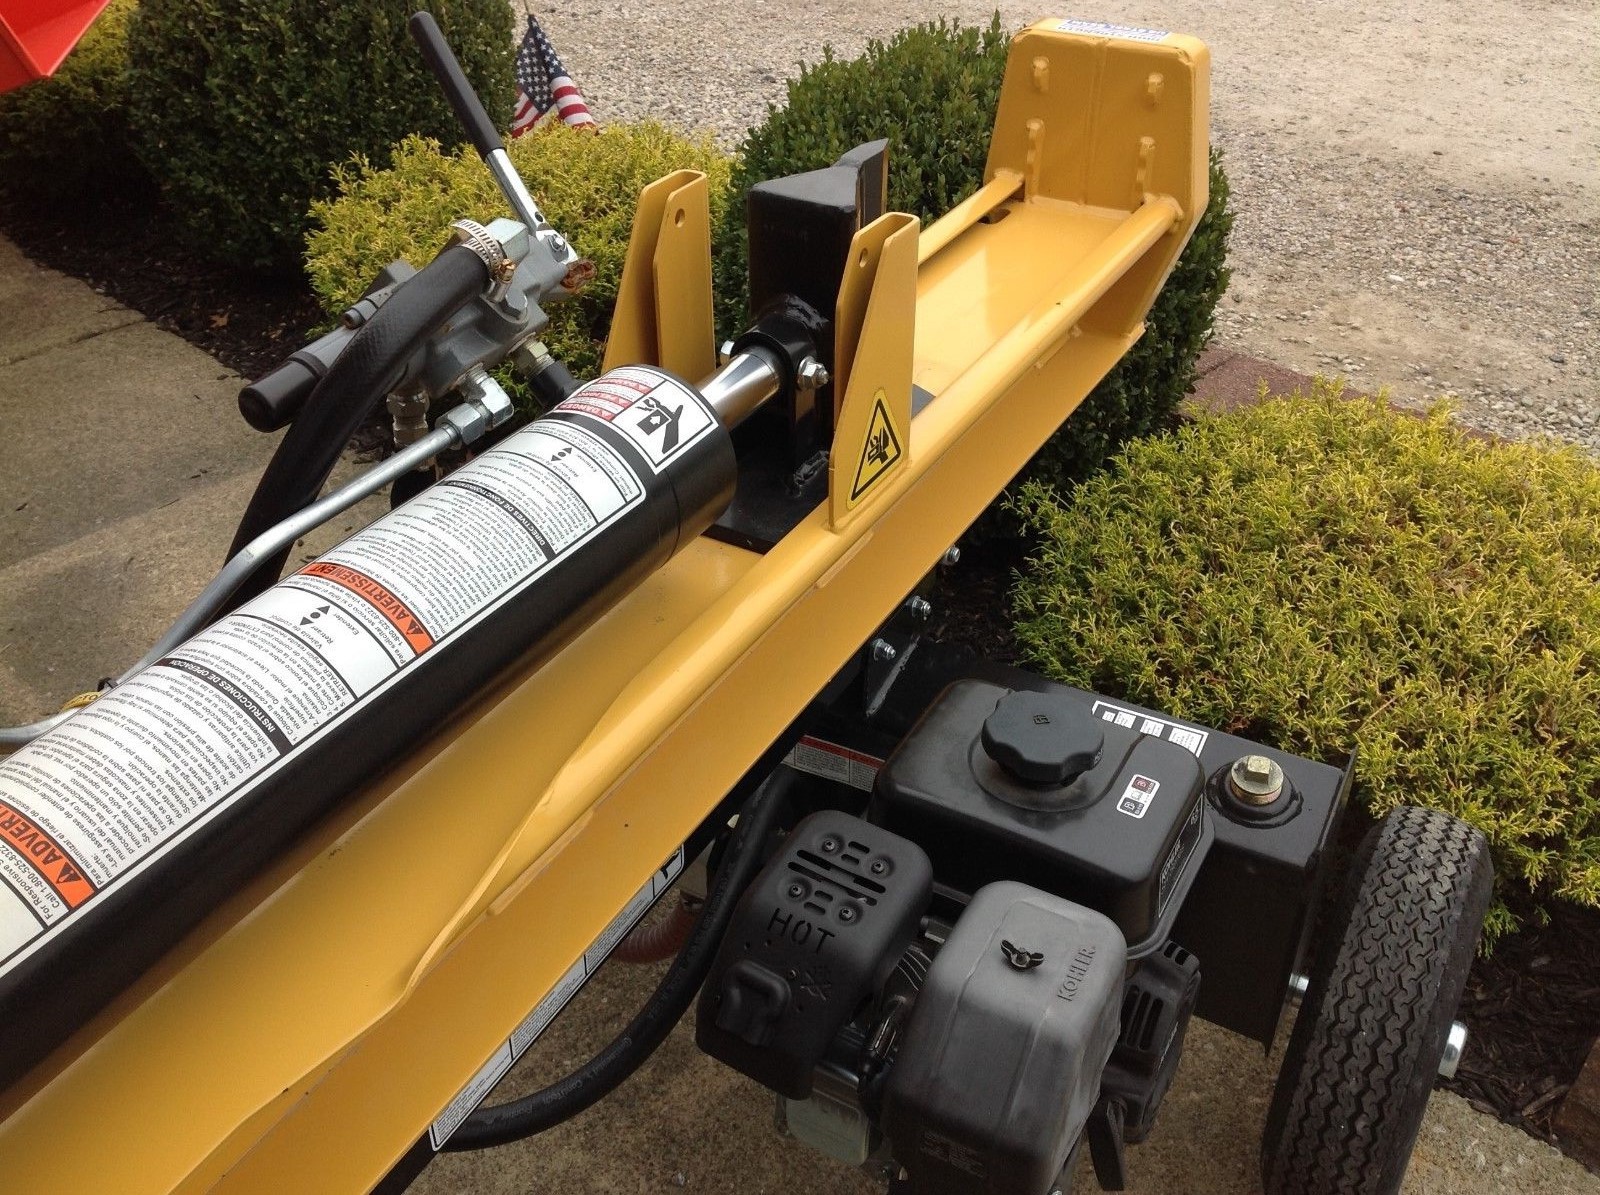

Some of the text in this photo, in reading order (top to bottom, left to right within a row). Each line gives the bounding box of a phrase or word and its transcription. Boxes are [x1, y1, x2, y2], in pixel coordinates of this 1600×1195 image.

[503, 503, 514, 512] DE
[512, 510, 545, 546] DIRECTIVES
[308, 564, 409, 622] AVERTISSEMENT
[332, 613, 359, 635] Extender
[290, 649, 300, 657] de
[393, 648, 405, 664] Para
[206, 673, 221, 682] DE
[295, 663, 316, 683] madera
[249, 678, 265, 690] toda
[300, 679, 308, 687] el
[323, 681, 341, 701] Mueva
[211, 692, 234, 711] alcohol
[239, 681, 268, 705] cortadora
[262, 689, 279, 705] Quite
[306, 685, 329, 711] Coloque
[319, 688, 334, 706] Corte
[179, 701, 204, 719] calzado
[192, 699, 203, 707] de
[217, 680, 275, 733] INSTRUCCIONES
[290, 692, 315, 721] Arranque
[200, 704, 233, 733] protección
[215, 706, 239, 726] equipo
[231, 709, 243, 719] del
[271, 709, 294, 735] Coloque
[123, 725, 146, 740] cuerpo
[171, 716, 197, 736] presión
[205, 720, 237, 750] antiparras
[228, 731, 237, 739] la
[235, 724, 243, 732] el
[241, 718, 267, 747] influencia
[146, 730, 181, 760] movimiento
[193, 734, 206, 746] alta
[235, 736, 250, 751] para
[241, 729, 259, 748] opere
[149, 743, 173, 763] manos,
[171, 726, 222, 775] inspecciones para
[203, 744, 214, 753] de
[247, 751, 258, 763] vos
[264, 745, 272, 753] la
[78, 760, 94, 771] para
[82, 753, 104, 768] deben
[106, 758, 126, 774] sobre
[112, 740, 166, 785] los troncos por los
[169, 762, 181, 773] las
[180, 758, 189, 767] en
[189, 754, 214, 780] opere en
[211, 752, 229, 771] aceite
[50, 777, 61, 785] de
[72, 768, 102, 790] operador
[91, 769, 114, 788] segura
[101, 766, 131, 791] mascotas
[124, 759, 158, 789] operación.
[124, 771, 141, 786] pase
[186, 765, 207, 786] partes
[226, 770, 236, 780] de
[38, 781, 63, 798] manual
[58, 782, 98, 813] operaciones
[99, 788, 109, 797] un
[111, 787, 127, 801] zona
[137, 785, 146, 793] ni
[144, 790, 160, 806] pare
[202, 785, 213, 796] las
[36, 791, 65, 812] entender
[106, 796, 122, 810] sólo
[124, 800, 133, 808] la
[157, 805, 166, 814] se
[160, 794, 182, 819] durante
[186, 796, 198, 808] los
[28, 809, 39, 818] de
[61, 810, 73, 820] de
[71, 805, 96, 828] usuario
[93, 811, 105, 822] las
[119, 807, 144, 833] permite
[131, 806, 141, 816] en
[36, 815, 60, 834] riesgo
[93, 826, 106, 838] del
[114, 817, 143, 849] remolque
[139, 813, 159, 836] operar
[55, 832, 65, 840] el
[107, 824, 135, 855] proceder
[61, 838, 92, 870] minimizar
[102, 836, 125, 861] manual
[89, 853, 112, 879] muerte:
[88, 868, 104, 885] Para
[1, 863, 53, 919] For Responsive
[45, 892, 60, 908] Call
[766, 908, 835, 954] HOT
[1057, 947, 1096, 1002] KOHLER
